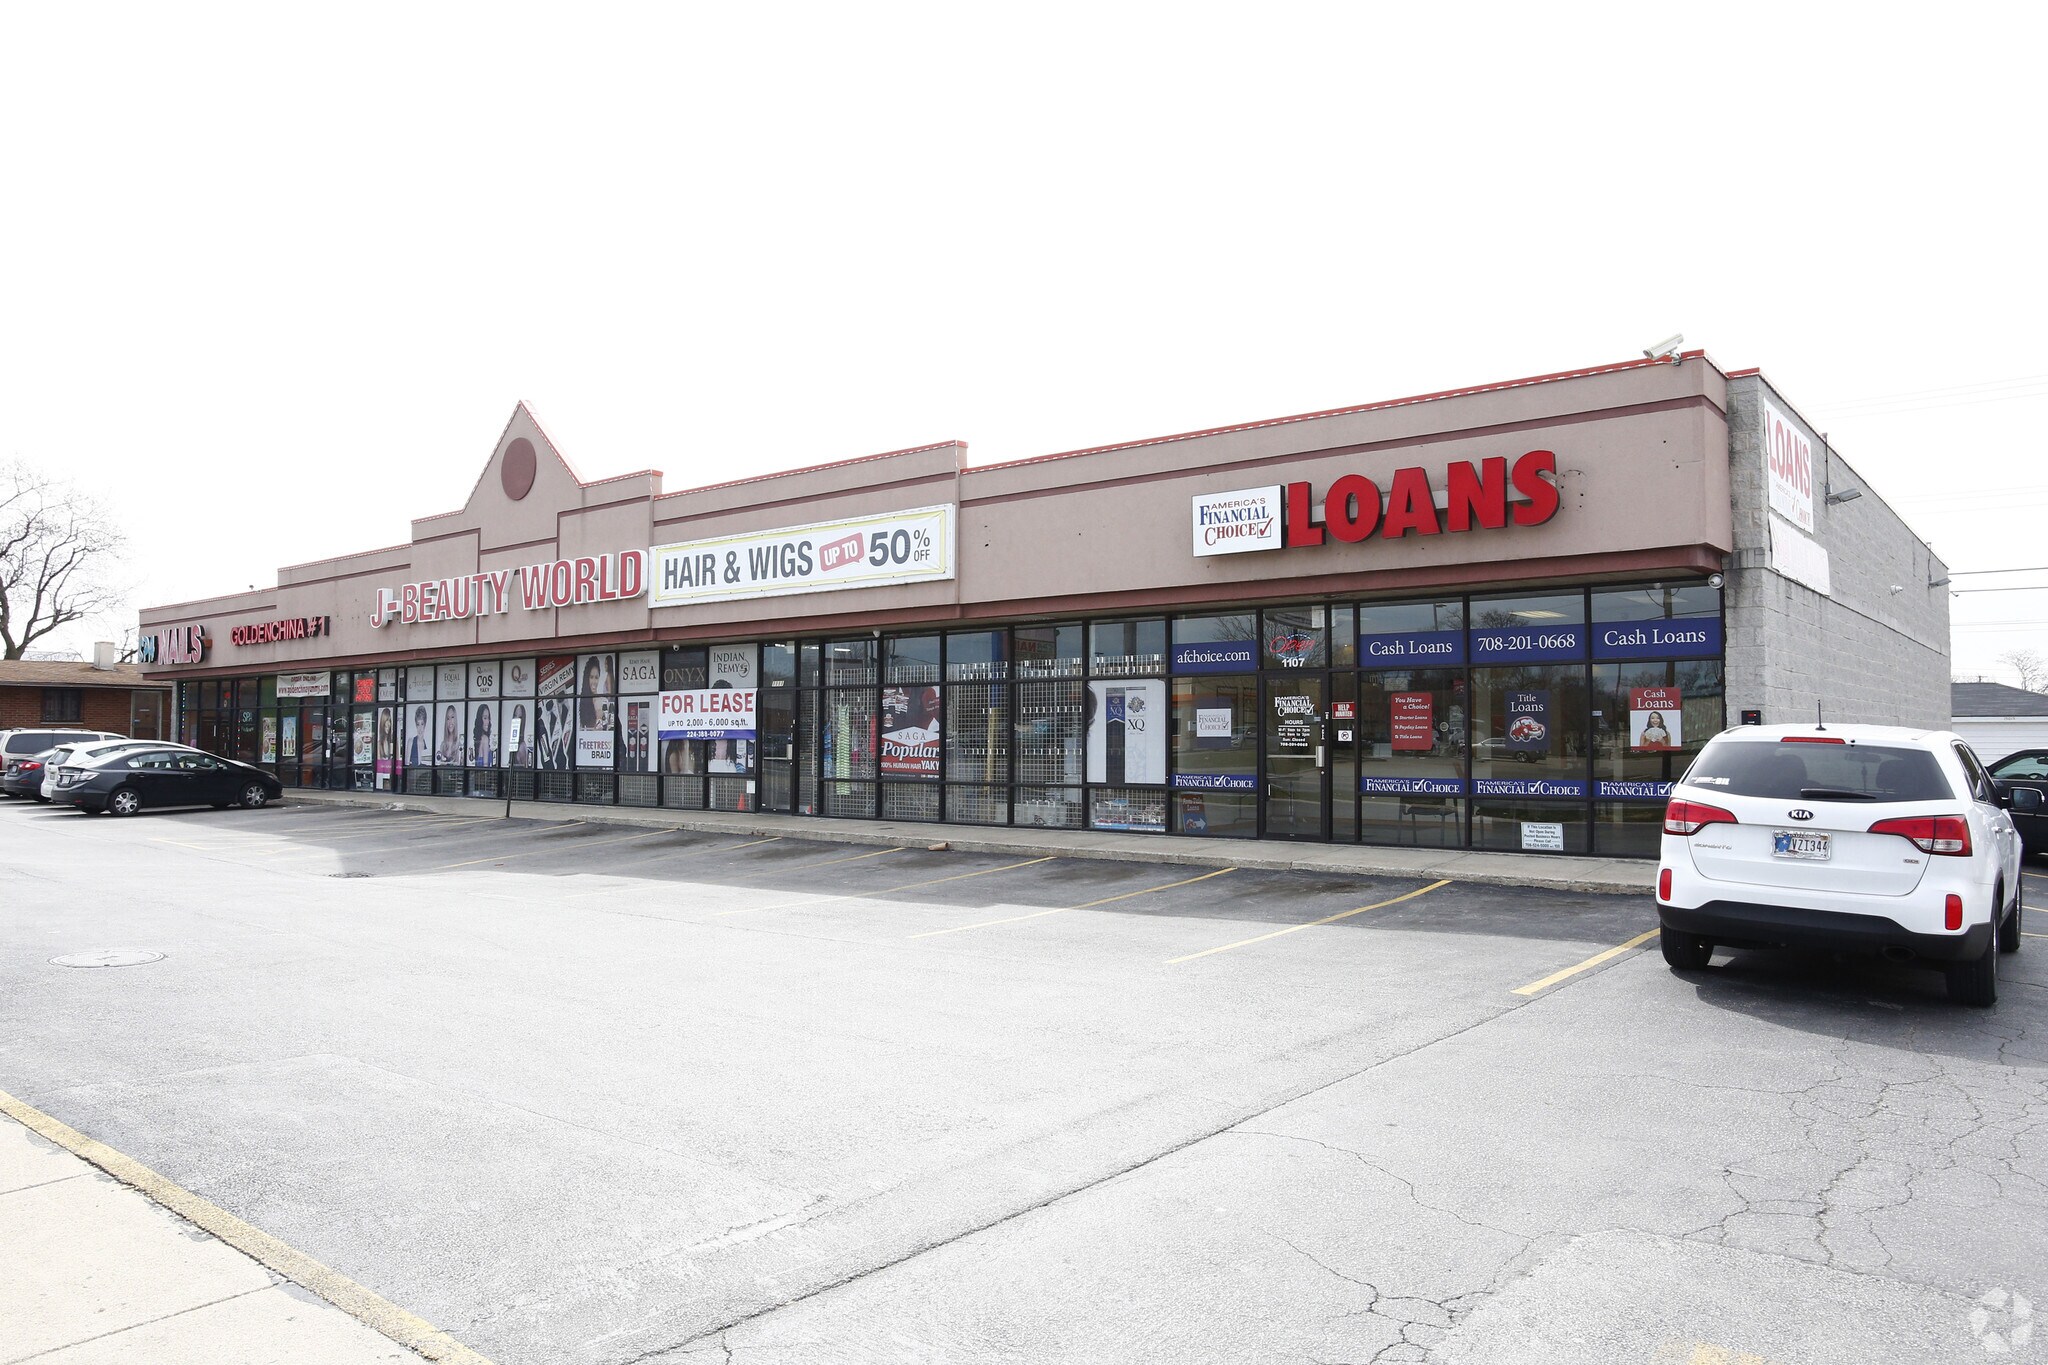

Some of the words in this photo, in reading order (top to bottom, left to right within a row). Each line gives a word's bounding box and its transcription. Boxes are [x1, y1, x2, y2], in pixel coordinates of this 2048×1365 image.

[1767, 409, 1811, 500] LOANS
[1210, 497, 1266, 510] AMERICA'S
[1287, 450, 1561, 548] LOANS
[1199, 505, 1270, 527] FINANCIAL
[1204, 521, 1257, 546] CHOICE
[823, 546, 840, 567] UP
[841, 539, 859, 561] TO
[868, 528, 911, 567] 50
[913, 548, 931, 562] OFF
[664, 553, 716, 590] HAIR
[723, 550, 740, 584] &
[748, 540, 814, 581] WIGS
[370, 568, 514, 629] J-BEAUTY
[520, 549, 649, 611] WORLD
[1477, 633, 1576, 652] 708-201-0668
[1604, 629, 1647, 646] Cash
[1652, 628, 1706, 644] Loans
[158, 624, 204, 665] NAILS
[1369, 640, 1405, 656] Cash
[1409, 639, 1453, 654] Loans
[713, 651, 745, 663] INDIAN
[1177, 649, 1251, 663] afchoice.com
[1282, 658, 1305, 668] 1107
[623, 665, 657, 681] SAGA
[663, 666, 705, 683] ONYX
[717, 663, 740, 674] REMY
[538, 678, 559, 695] VIRGIN
[1517, 693, 1537, 702] Title
[1643, 689, 1666, 699] Cash
[662, 694, 694, 714] FOR
[700, 692, 754, 713] LEASE
[1274, 697, 1311, 708] FINANCIAL
[1338, 703, 1350, 711] HELP
[1510, 701, 1544, 712] Loans
[1636, 697, 1674, 709] Loans
[1277, 706, 1306, 717] CHOICE
[708, 718, 729, 727] 6,000
[1127, 718, 1145, 731] XQ
[1198, 714, 1227, 724] FINANCIAL
[1200, 722, 1222, 731] CHOICE
[898, 731, 926, 740] SAGA
[591, 751, 611, 760] BRAID
[881, 740, 940, 761] Popular
[921, 760, 940, 770] YAKY
[1175, 775, 1215, 787] FINANCIAL
[1223, 777, 1254, 788] CHOICE
[1366, 778, 1413, 792] FINANCIAL
[1423, 778, 1460, 793] CHOICE
[1476, 780, 1528, 795] FINANCIAL
[1540, 782, 1581, 795] CHOICE
[1600, 781, 1657, 796] FINANCIAL
[1790, 810, 1811, 818] KIA
